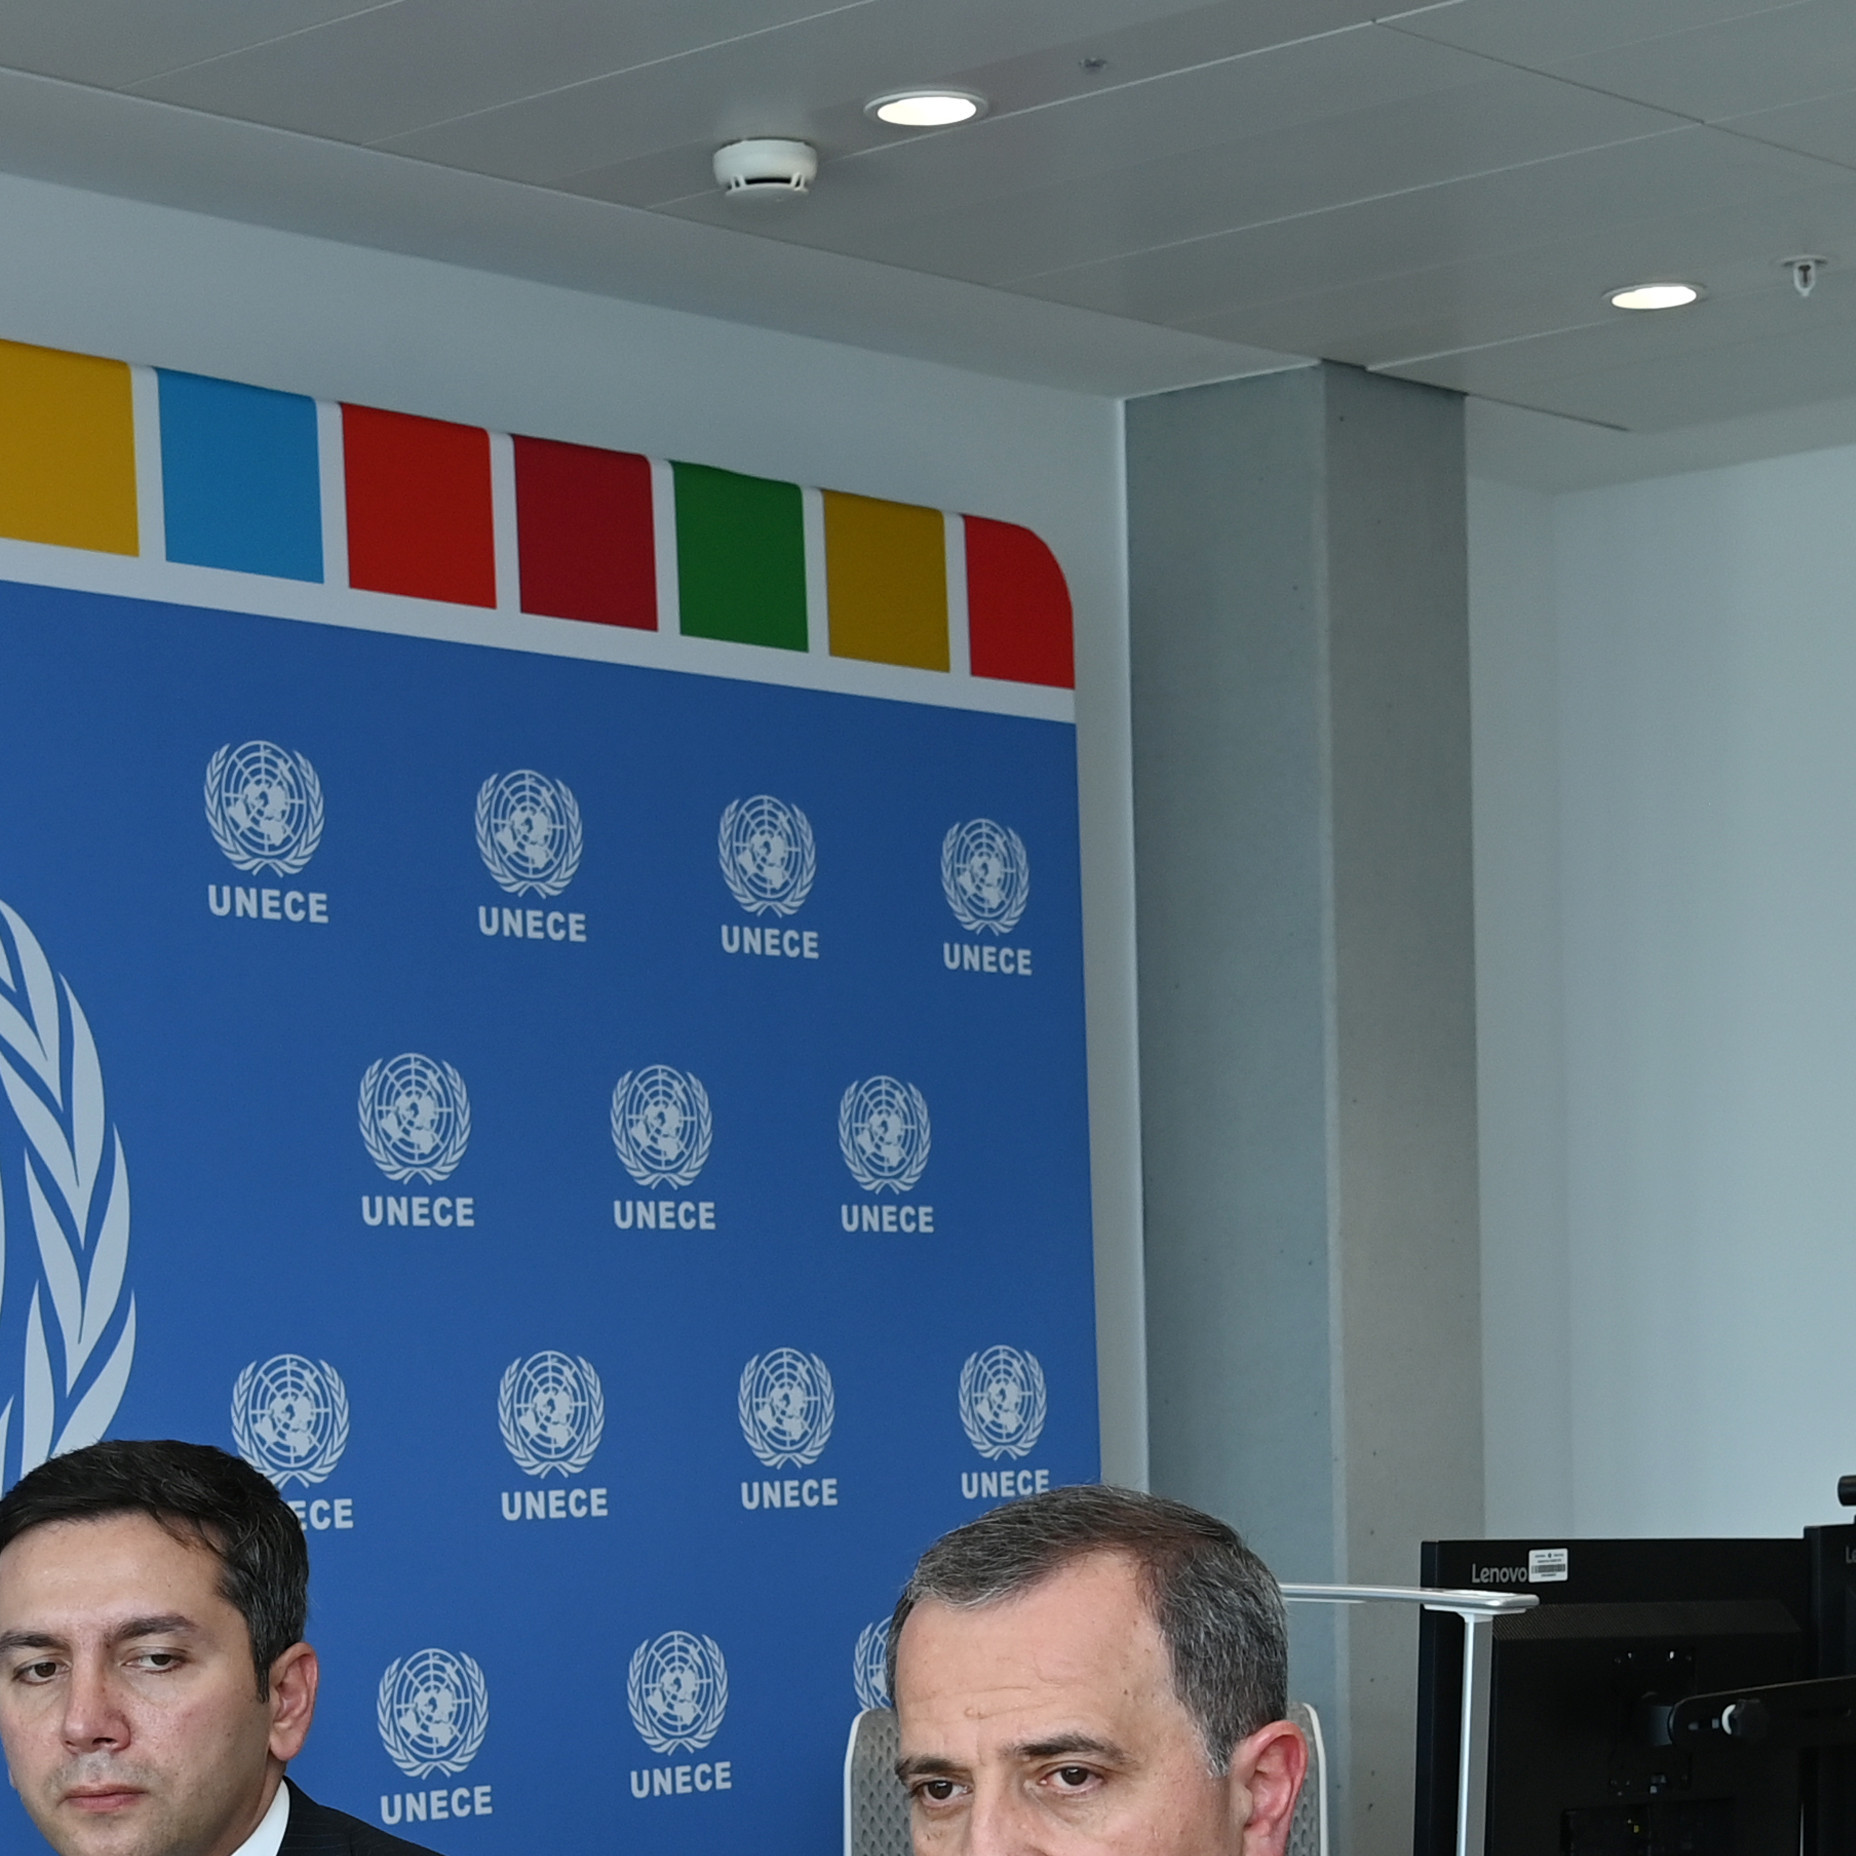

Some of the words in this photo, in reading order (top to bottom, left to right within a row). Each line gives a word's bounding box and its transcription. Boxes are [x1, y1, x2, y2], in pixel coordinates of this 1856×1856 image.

[209, 885, 328, 923] UNECE
[479, 906, 586, 942] UNECE
[722, 925, 819, 959] UNECE
[944, 943, 1032, 975] UNECE
[362, 1196, 475, 1227] UNECE
[614, 1200, 716, 1230] UNECE
[842, 1205, 934, 1232] UNECE
[741, 1478, 838, 1510] UNECE
[961, 1469, 1049, 1499] UNECE
[287, 1498, 354, 1530] ECE
[502, 1488, 608, 1521] UNECE
[1471, 1563, 1527, 1583] Lenovo
[631, 1761, 732, 1798] UNECE
[380, 1785, 493, 1825] UNECE
